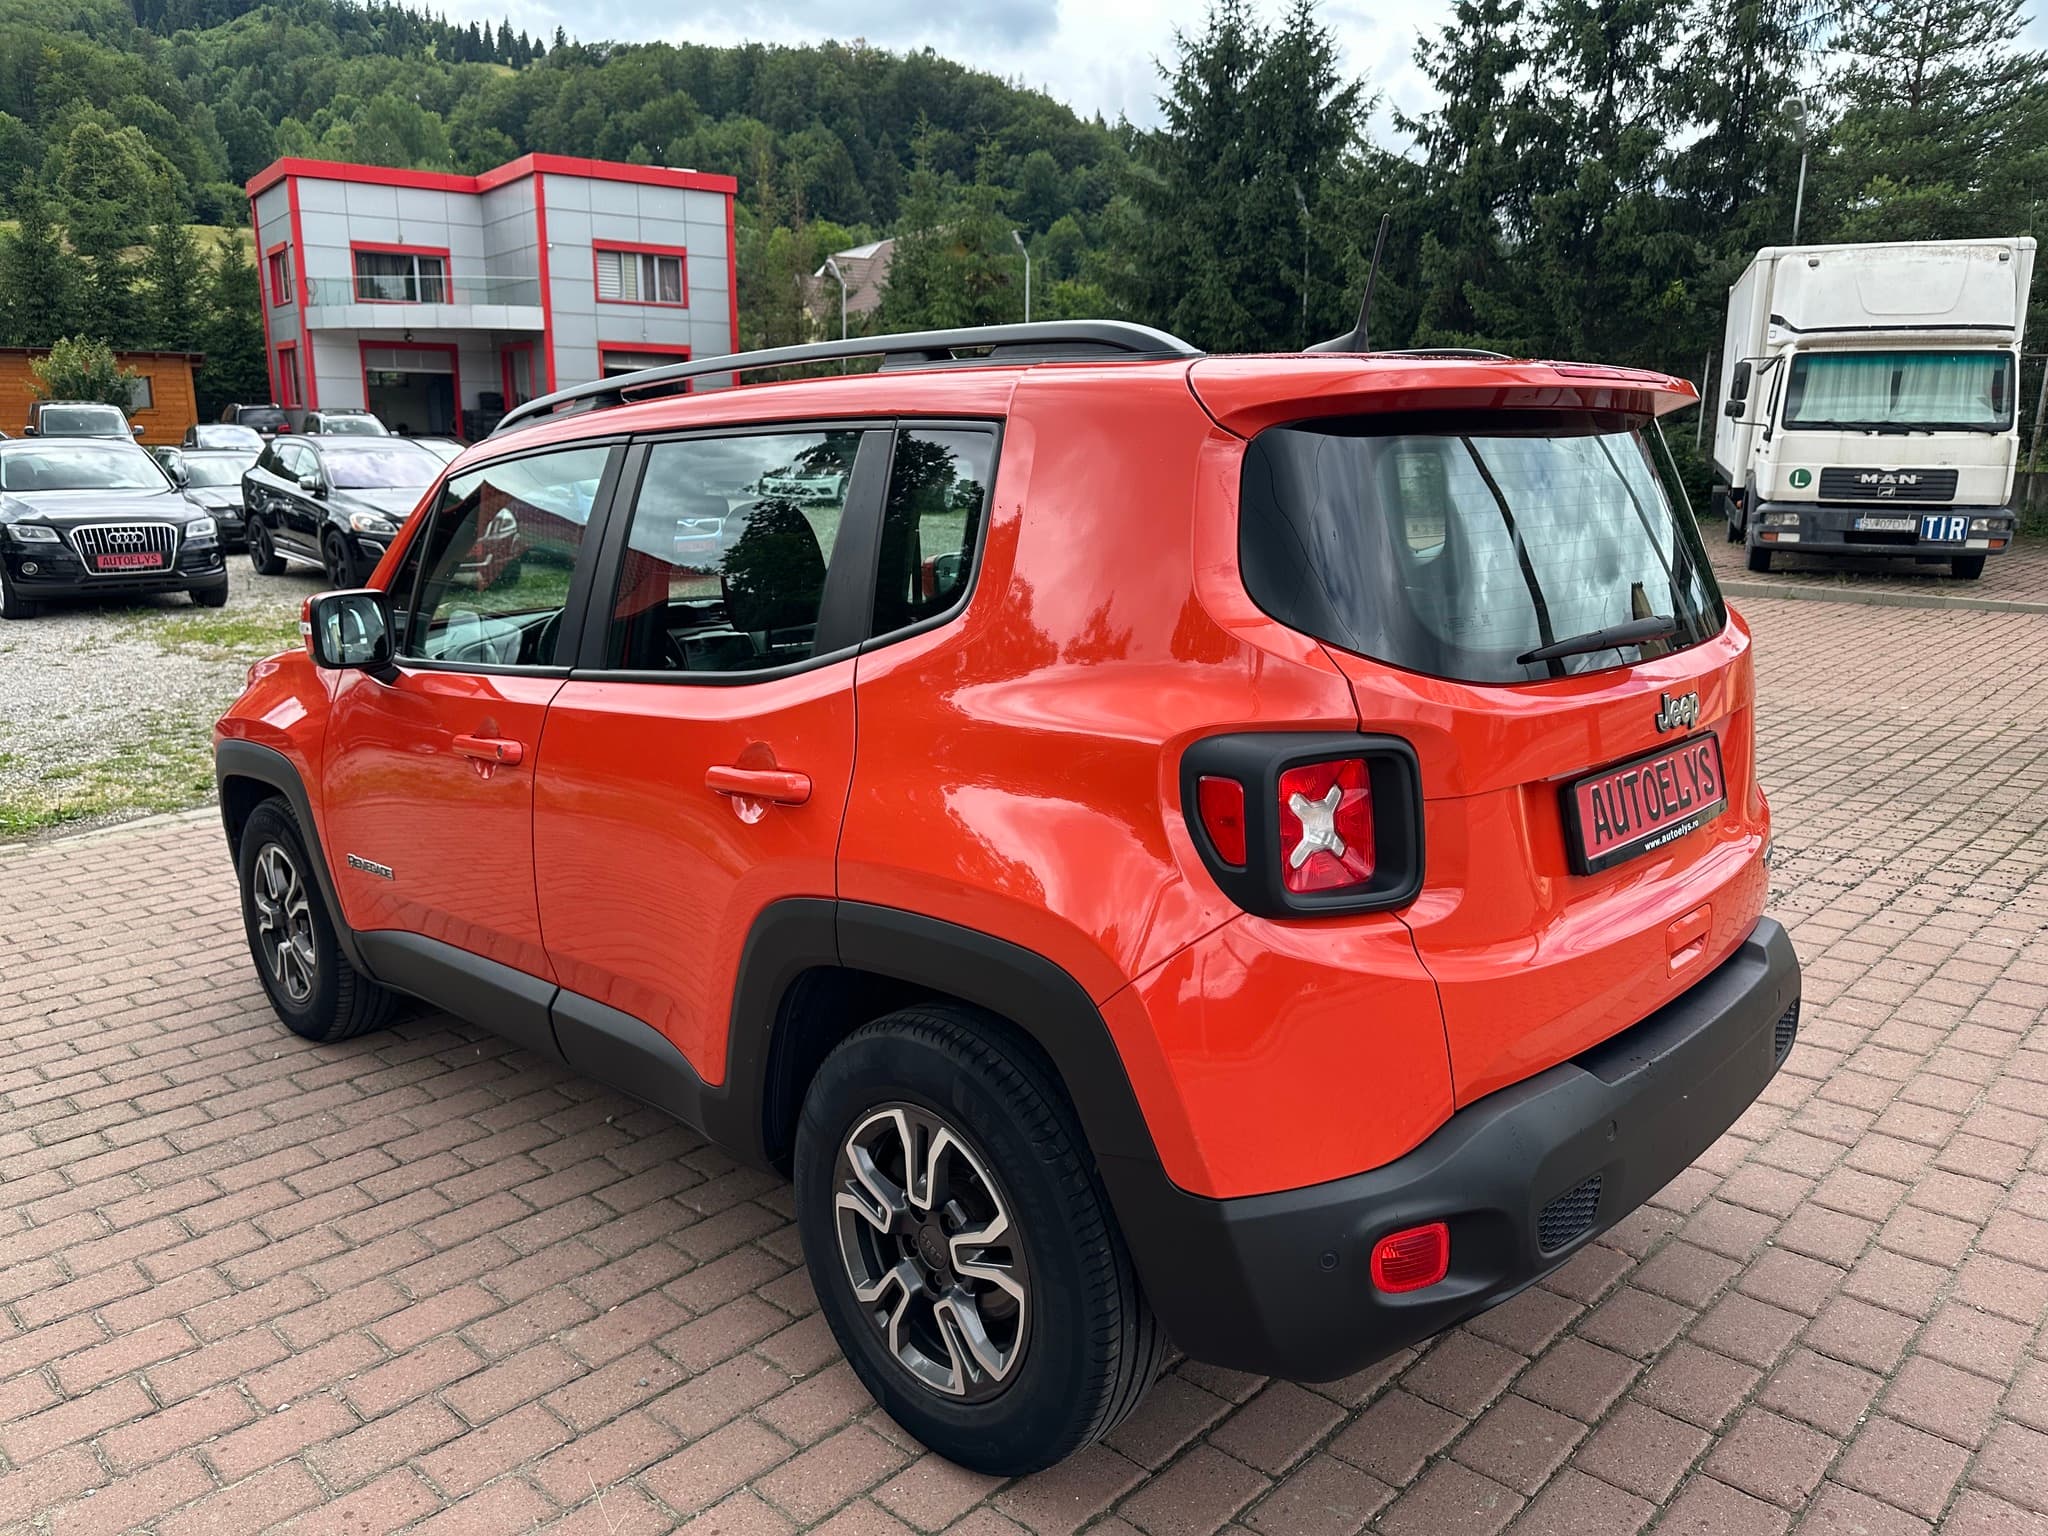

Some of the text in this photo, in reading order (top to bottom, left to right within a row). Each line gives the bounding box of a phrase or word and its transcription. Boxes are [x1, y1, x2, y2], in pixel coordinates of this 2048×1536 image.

[1794, 471, 1805, 486] L
[1860, 473, 1918, 485] MAN
[1925, 517, 1965, 540] TIR
[102, 554, 159, 567] AUTOELYS
[1655, 691, 1699, 734] Jeep
[1590, 745, 1716, 845] AUTOELYS
[1644, 820, 1699, 851] www.autoelys.ro
[347, 853, 393, 881] RENEGADE
